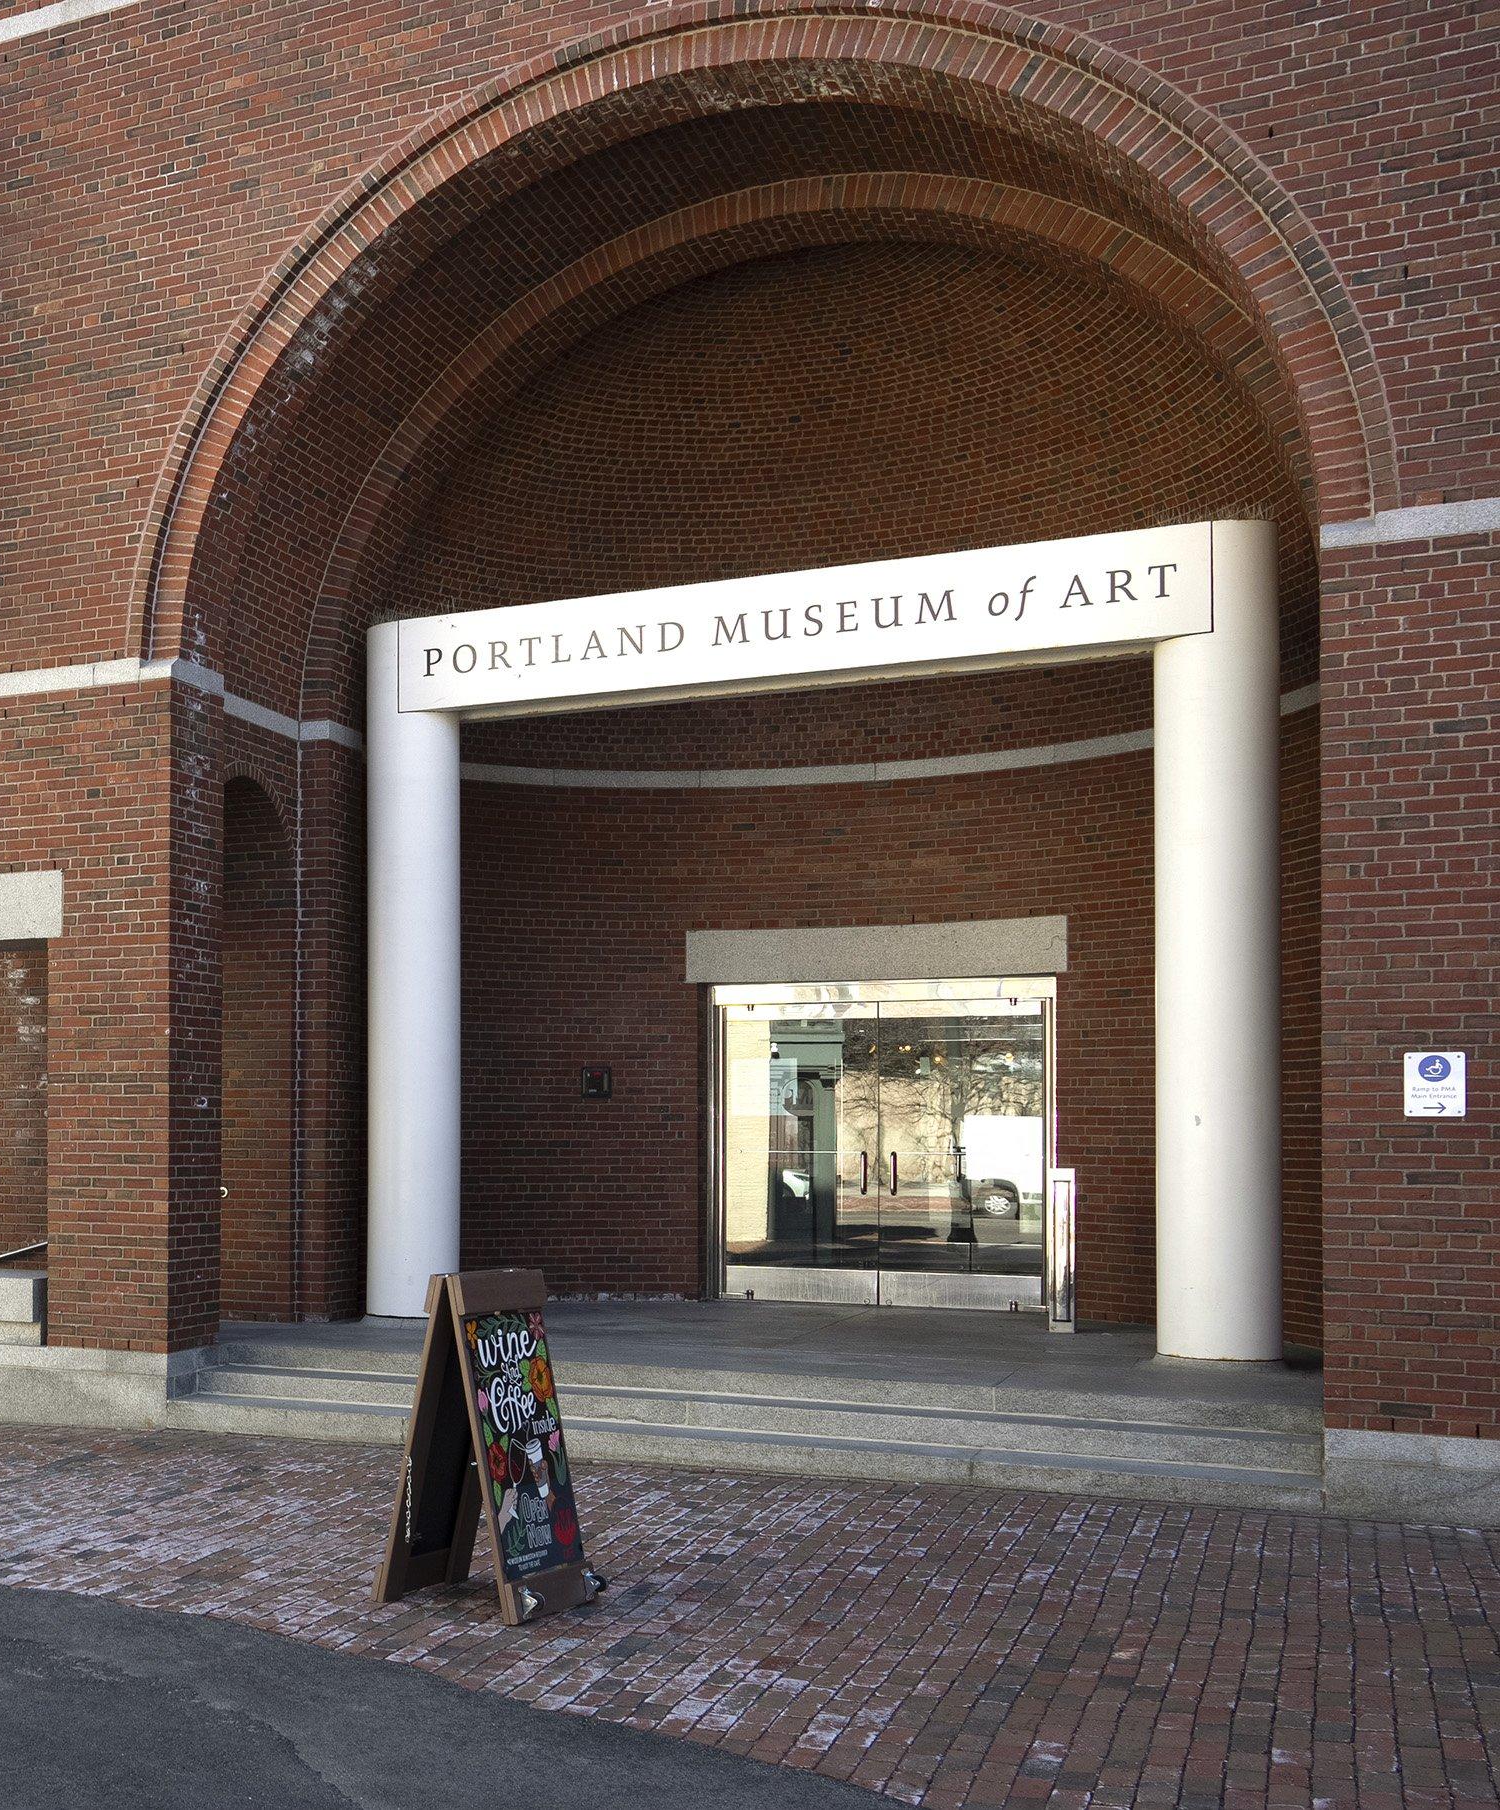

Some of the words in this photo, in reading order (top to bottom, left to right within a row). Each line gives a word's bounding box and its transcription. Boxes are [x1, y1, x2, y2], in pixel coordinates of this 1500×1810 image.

[422, 621, 685, 677] PORTLAND
[711, 589, 957, 646] MUSEUM
[987, 575, 1037, 621] of
[1059, 563, 1177, 608] ART
[477, 1329, 537, 1368] wine
[531, 1410, 556, 1435] inside
